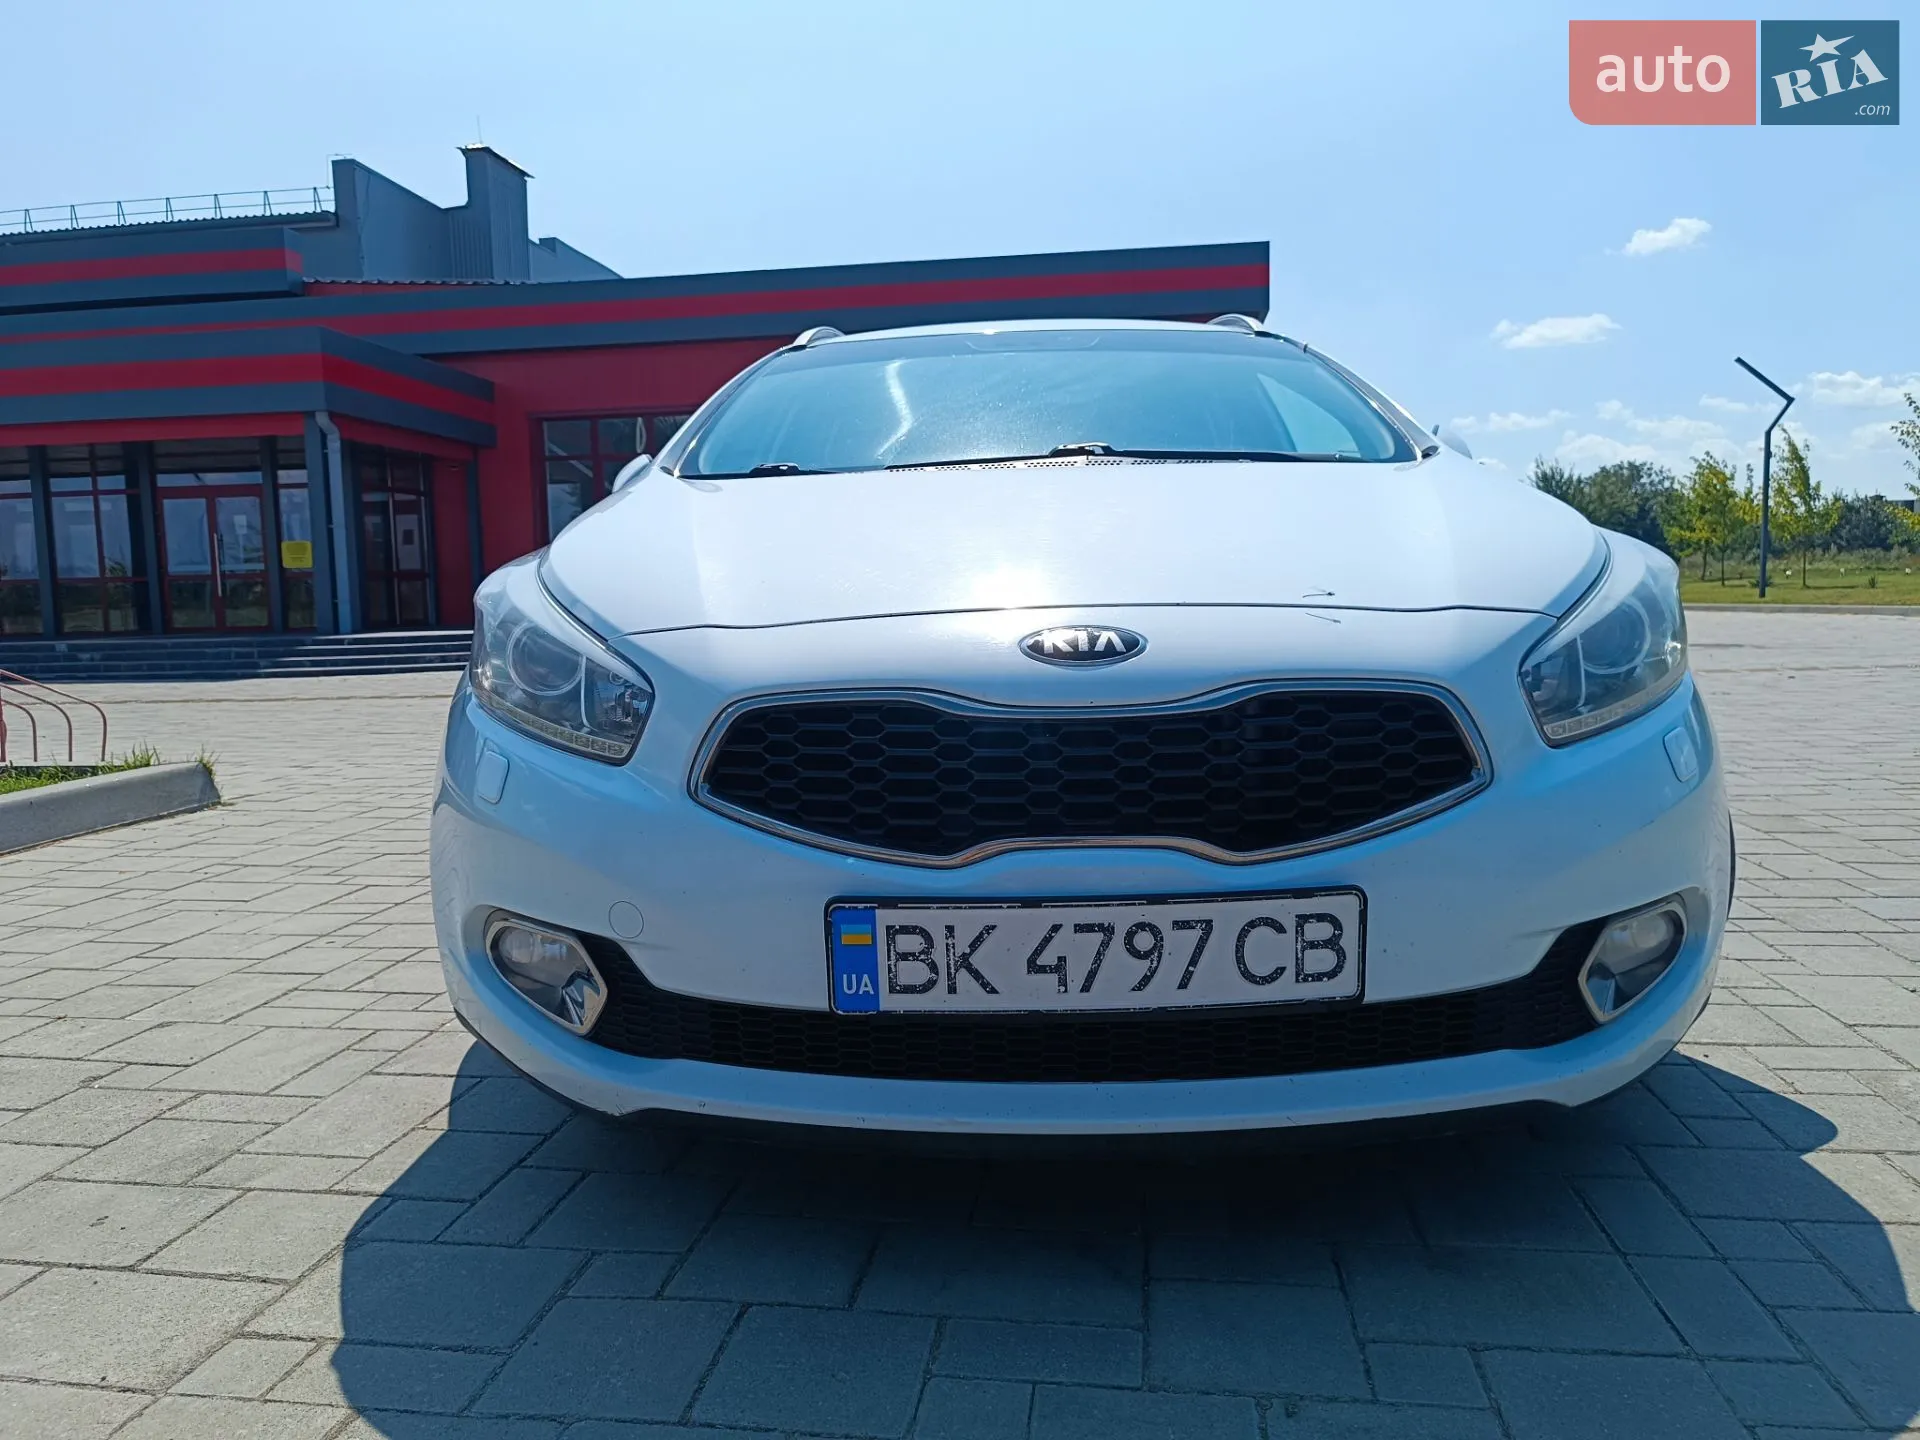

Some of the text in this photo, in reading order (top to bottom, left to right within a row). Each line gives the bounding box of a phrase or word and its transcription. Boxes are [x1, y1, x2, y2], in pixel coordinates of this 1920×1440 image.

[1042, 628, 1127, 654] KIA
[885, 912, 1348, 996] BK 4797 CB
[842, 973, 875, 996] UA
